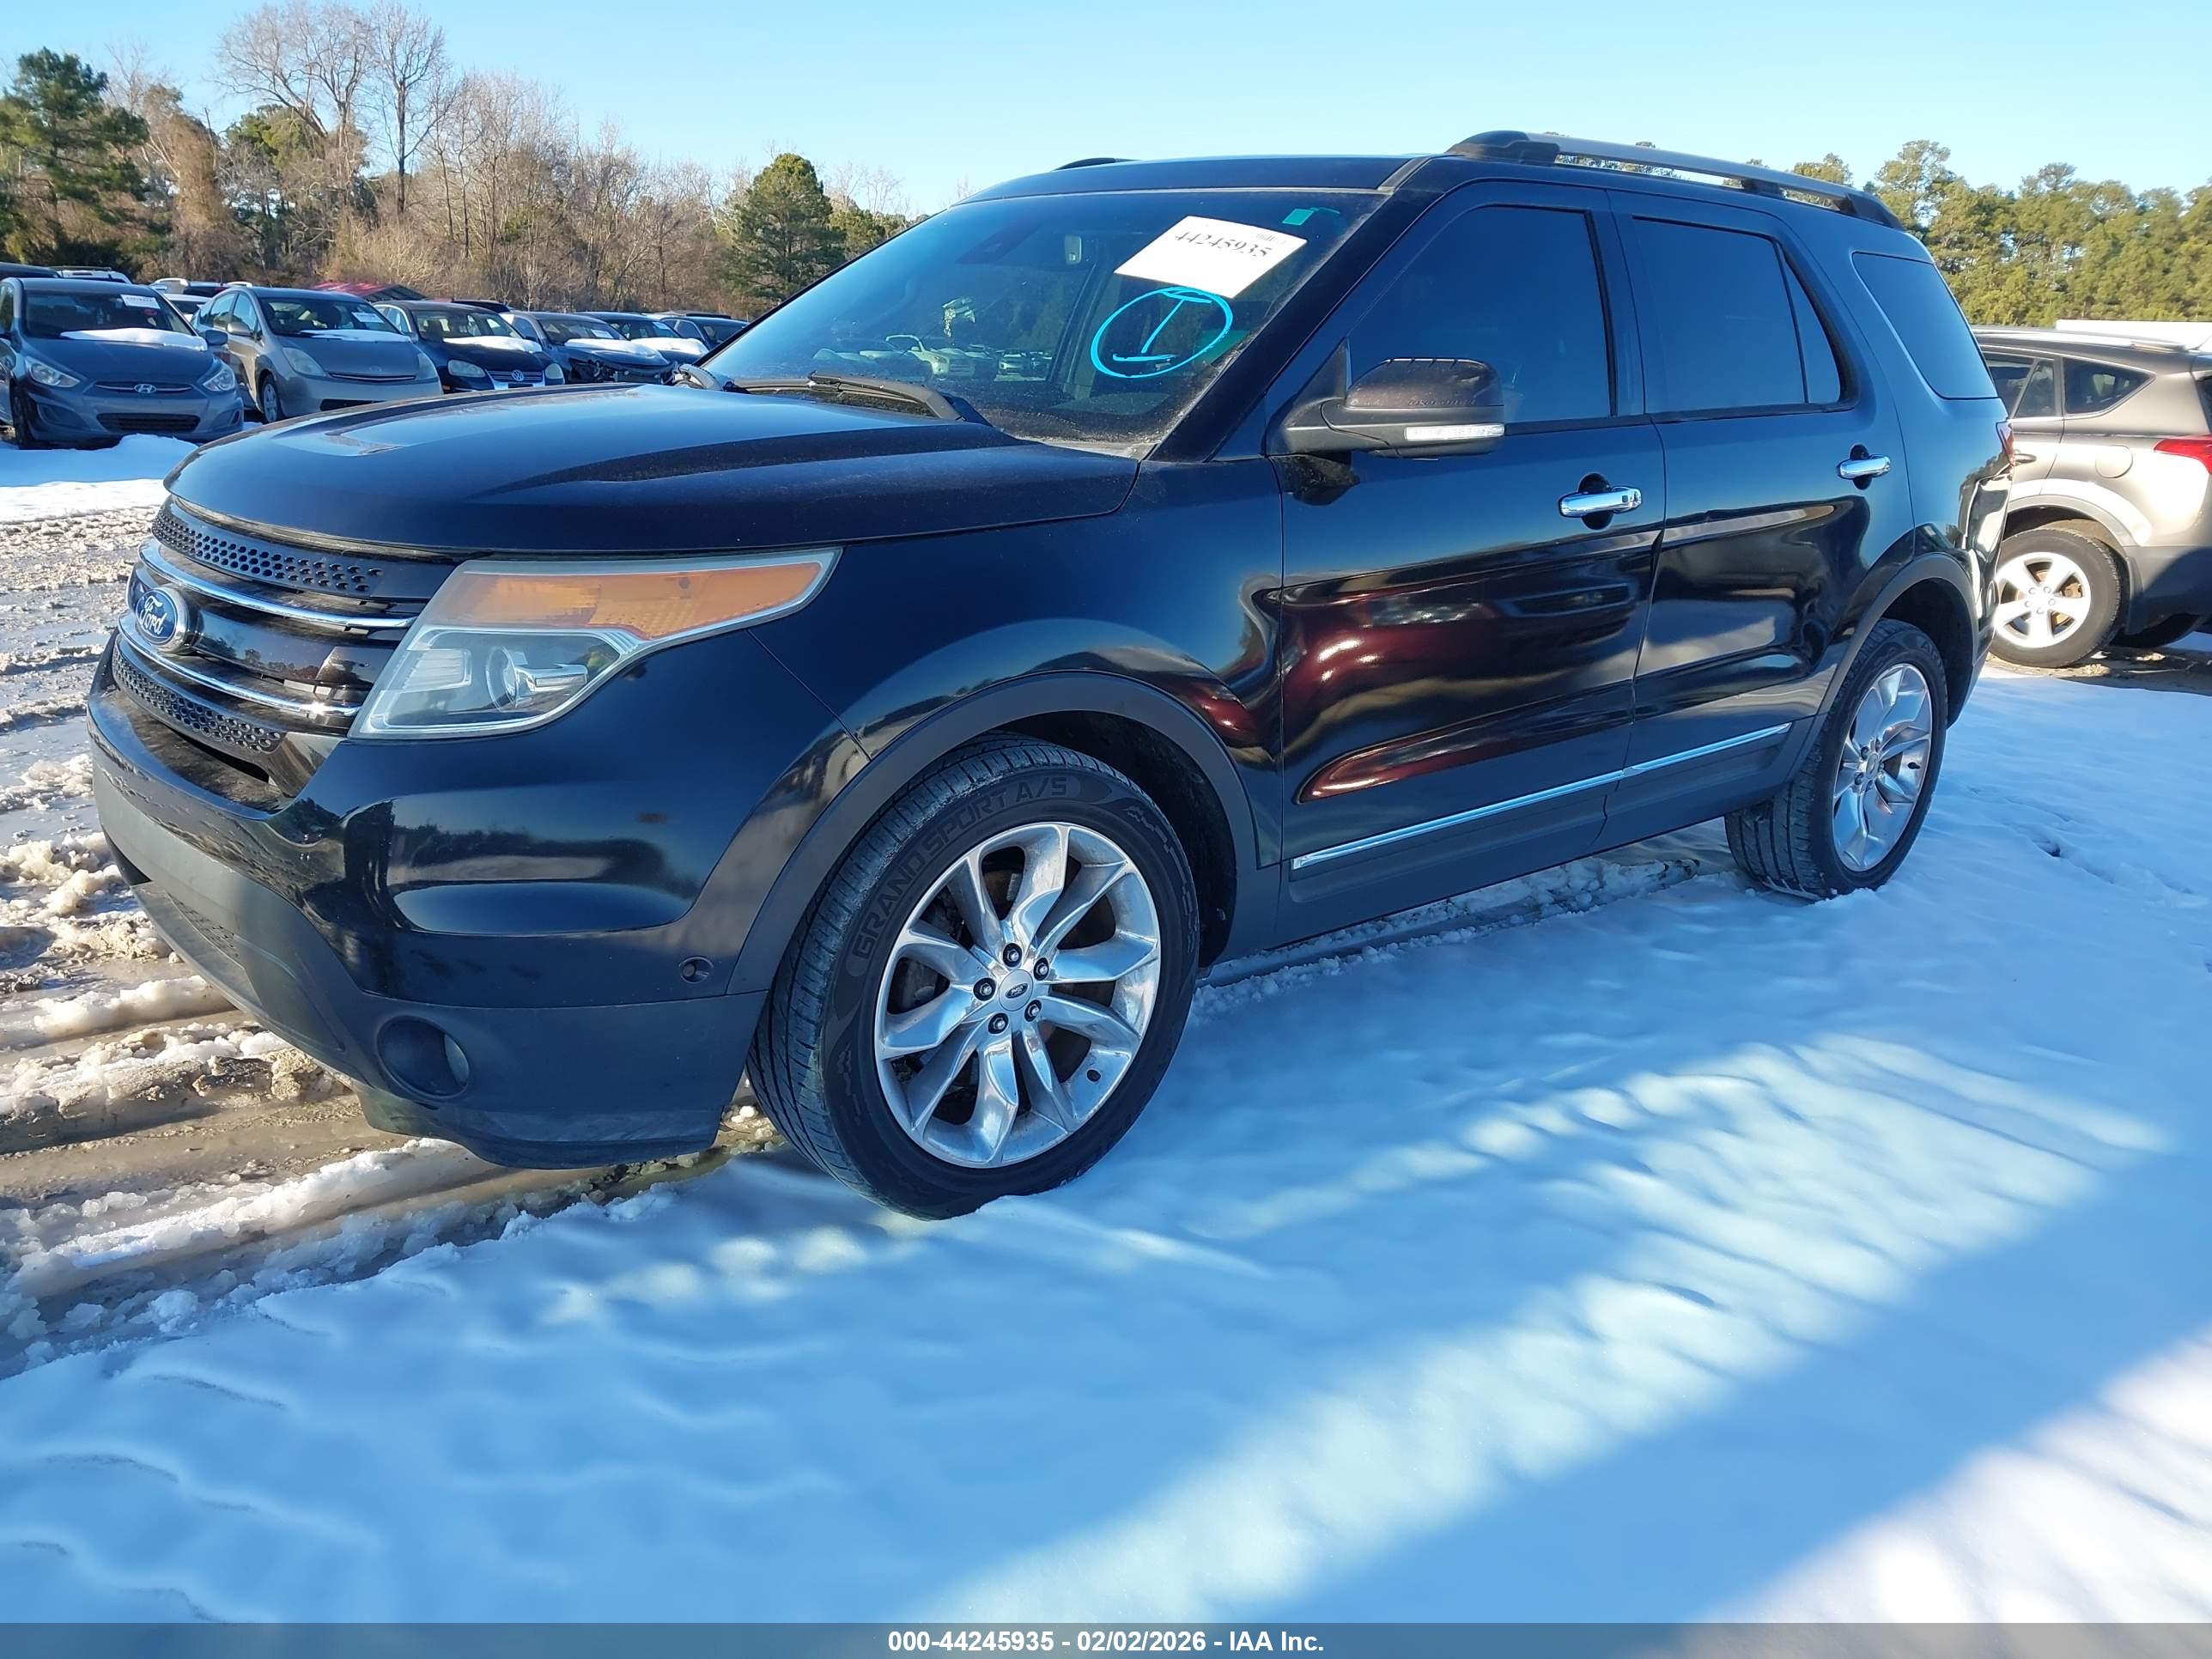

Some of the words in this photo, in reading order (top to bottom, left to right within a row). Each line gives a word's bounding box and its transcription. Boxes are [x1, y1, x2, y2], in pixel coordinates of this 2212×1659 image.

[1175, 231, 1273, 258] 44245935
[139, 595, 168, 635] Ford
[852, 852, 925, 959] GRAND
[924, 787, 1007, 856] SPORT
[1016, 776, 1067, 802] A/S
